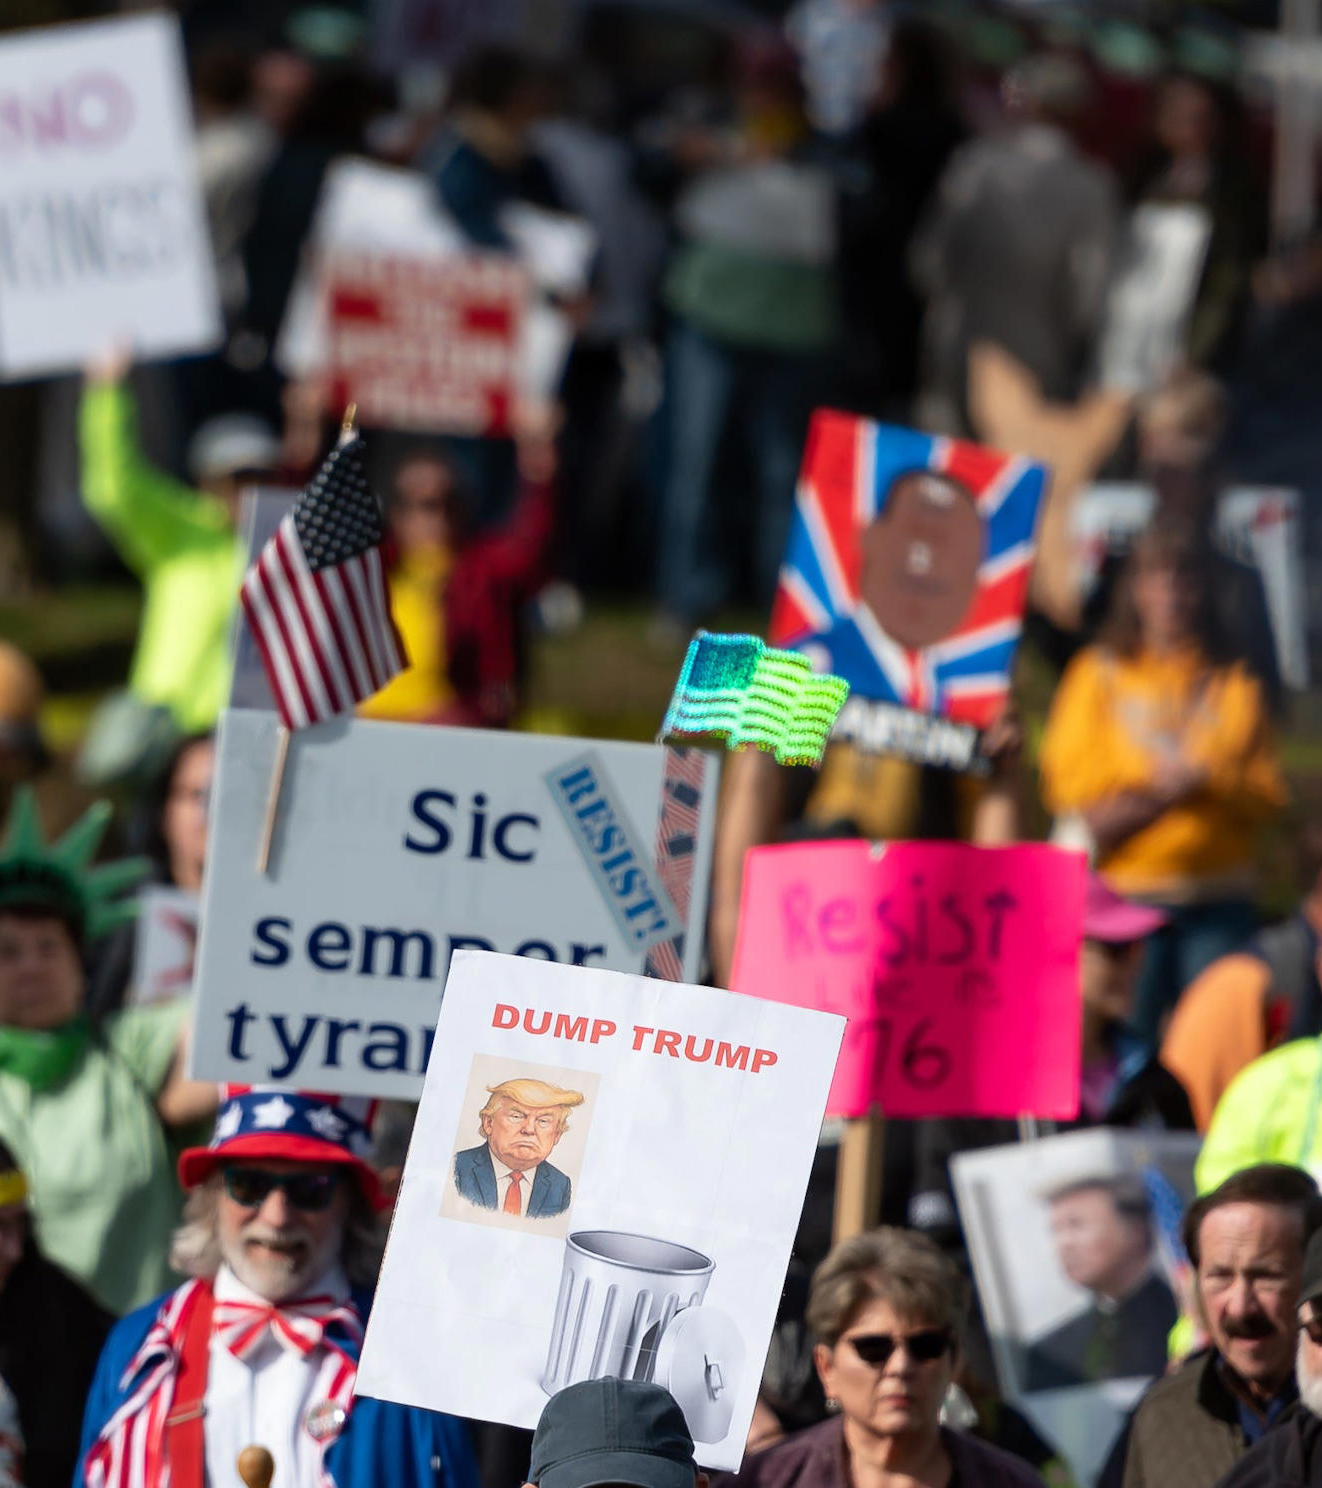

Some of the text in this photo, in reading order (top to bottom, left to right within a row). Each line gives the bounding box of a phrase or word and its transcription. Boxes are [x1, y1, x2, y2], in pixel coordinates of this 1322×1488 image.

[403, 787, 541, 864] Sic
[558, 765, 670, 941] RESIST!
[490, 1003, 778, 1074] DUMP TRUMP
